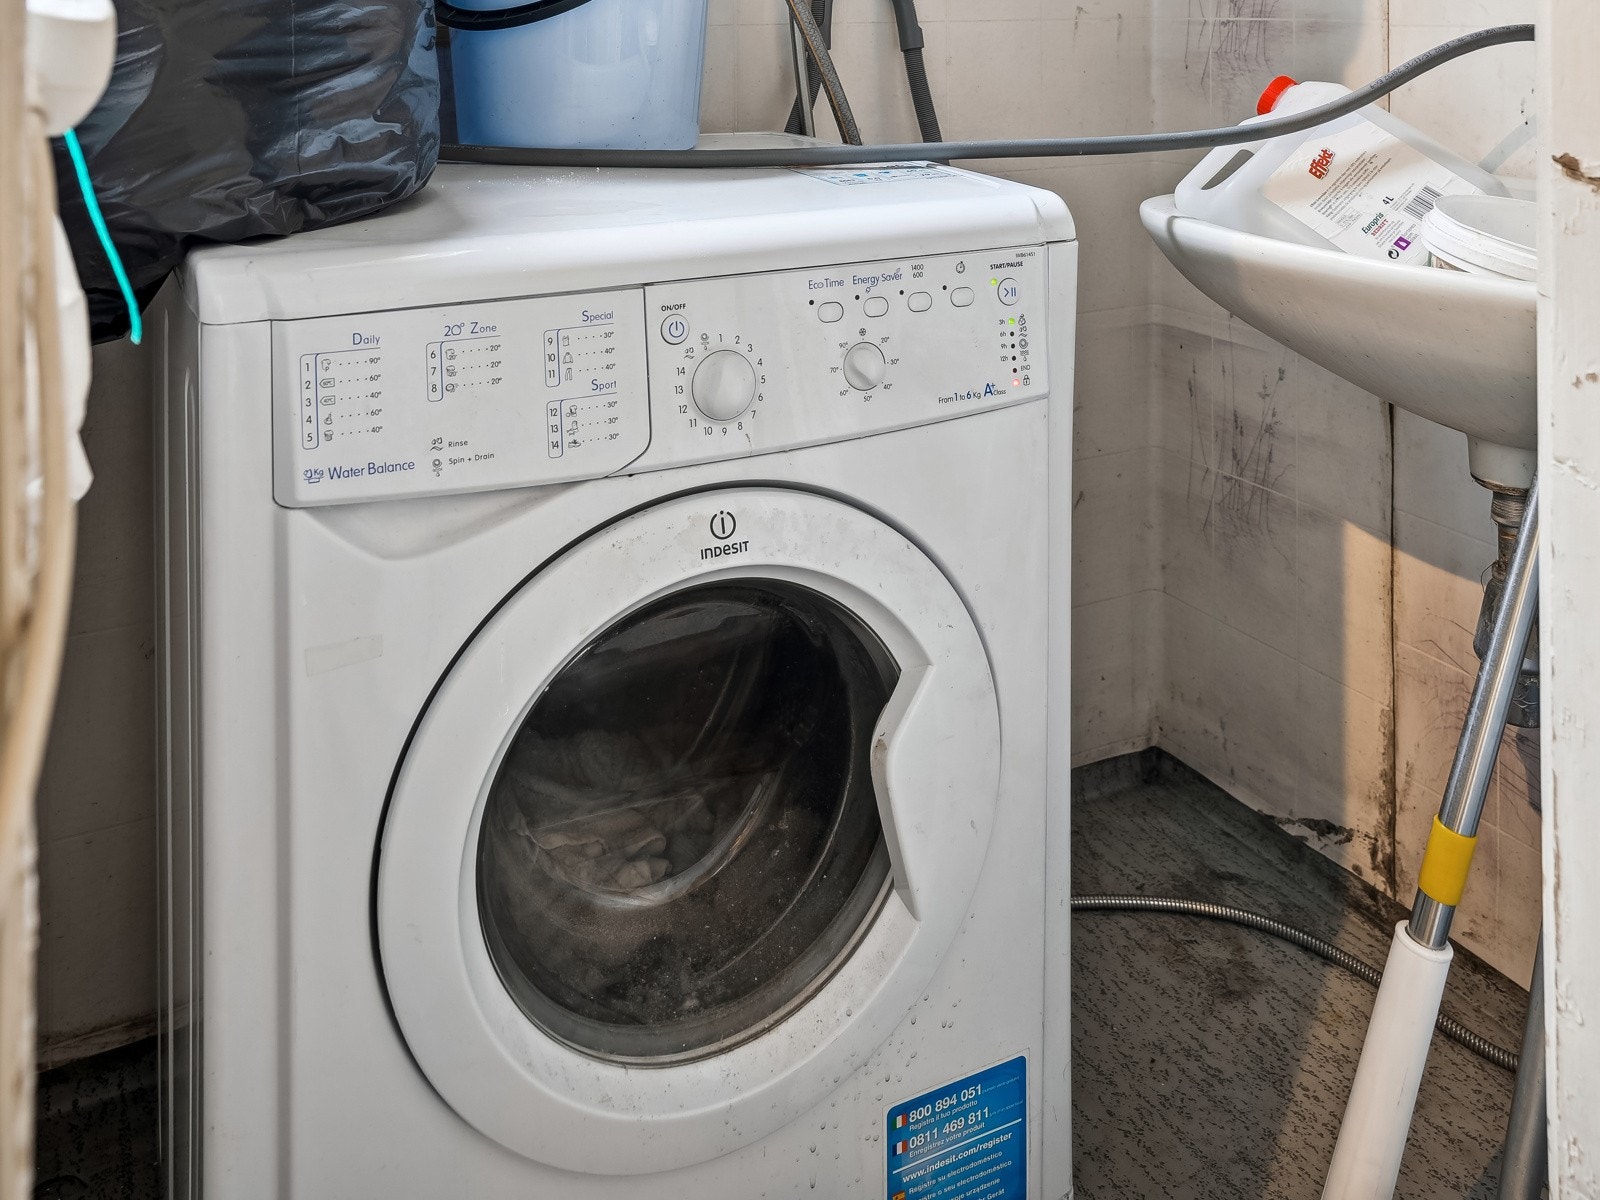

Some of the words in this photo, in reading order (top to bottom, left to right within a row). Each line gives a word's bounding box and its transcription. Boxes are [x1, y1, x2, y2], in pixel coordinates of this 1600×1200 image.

[1308, 147, 1336, 180] Effekt
[1361, 212, 1384, 234] Europris
[910, 263, 924, 271] 1400
[990, 261, 1024, 270] START/PAUSE
[852, 275, 880, 286] Energy
[881, 271, 903, 282] Saver
[661, 302, 687, 312] ON/OFF
[581, 309, 614, 323] Special
[470, 321, 497, 335] Zone
[352, 332, 381, 347] Daily
[547, 353, 556, 362] 10
[547, 369, 556, 378] 11
[676, 367, 686, 376] 14
[591, 378, 617, 393] Sport
[674, 385, 684, 395] 13
[938, 395, 954, 405] From
[959, 393, 966, 401] to
[973, 391, 981, 400] Kg
[549, 408, 558, 417] 12
[678, 405, 688, 414] 12
[550, 424, 559, 433] 13
[689, 419, 697, 428] 11
[703, 427, 713, 436] 10
[448, 439, 468, 449] Rinse
[551, 440, 560, 450] 14
[448, 456, 464, 467] Spin
[474, 452, 495, 462] Drain
[328, 465, 365, 481] Water
[368, 460, 415, 475] Balance
[909, 1104, 932, 1123] 800
[935, 1093, 957, 1112] 894
[960, 1083, 981, 1101] 051
[909, 1117, 935, 1132] Registra
[940, 1110, 951, 1119] tuo
[952, 1100, 978, 1115] prodotto
[909, 1127, 938, 1149] 0811
[942, 1116, 965, 1134] 469
[968, 1106, 989, 1125] 811
[909, 1138, 945, 1158] Enregistrez
[945, 1132, 961, 1143] votre
[962, 1122, 985, 1137] produit
[902, 1131, 1013, 1183] www.indesit.com/register
[908, 1177, 937, 1195] Registre
[944, 1183, 956, 1192] seu
